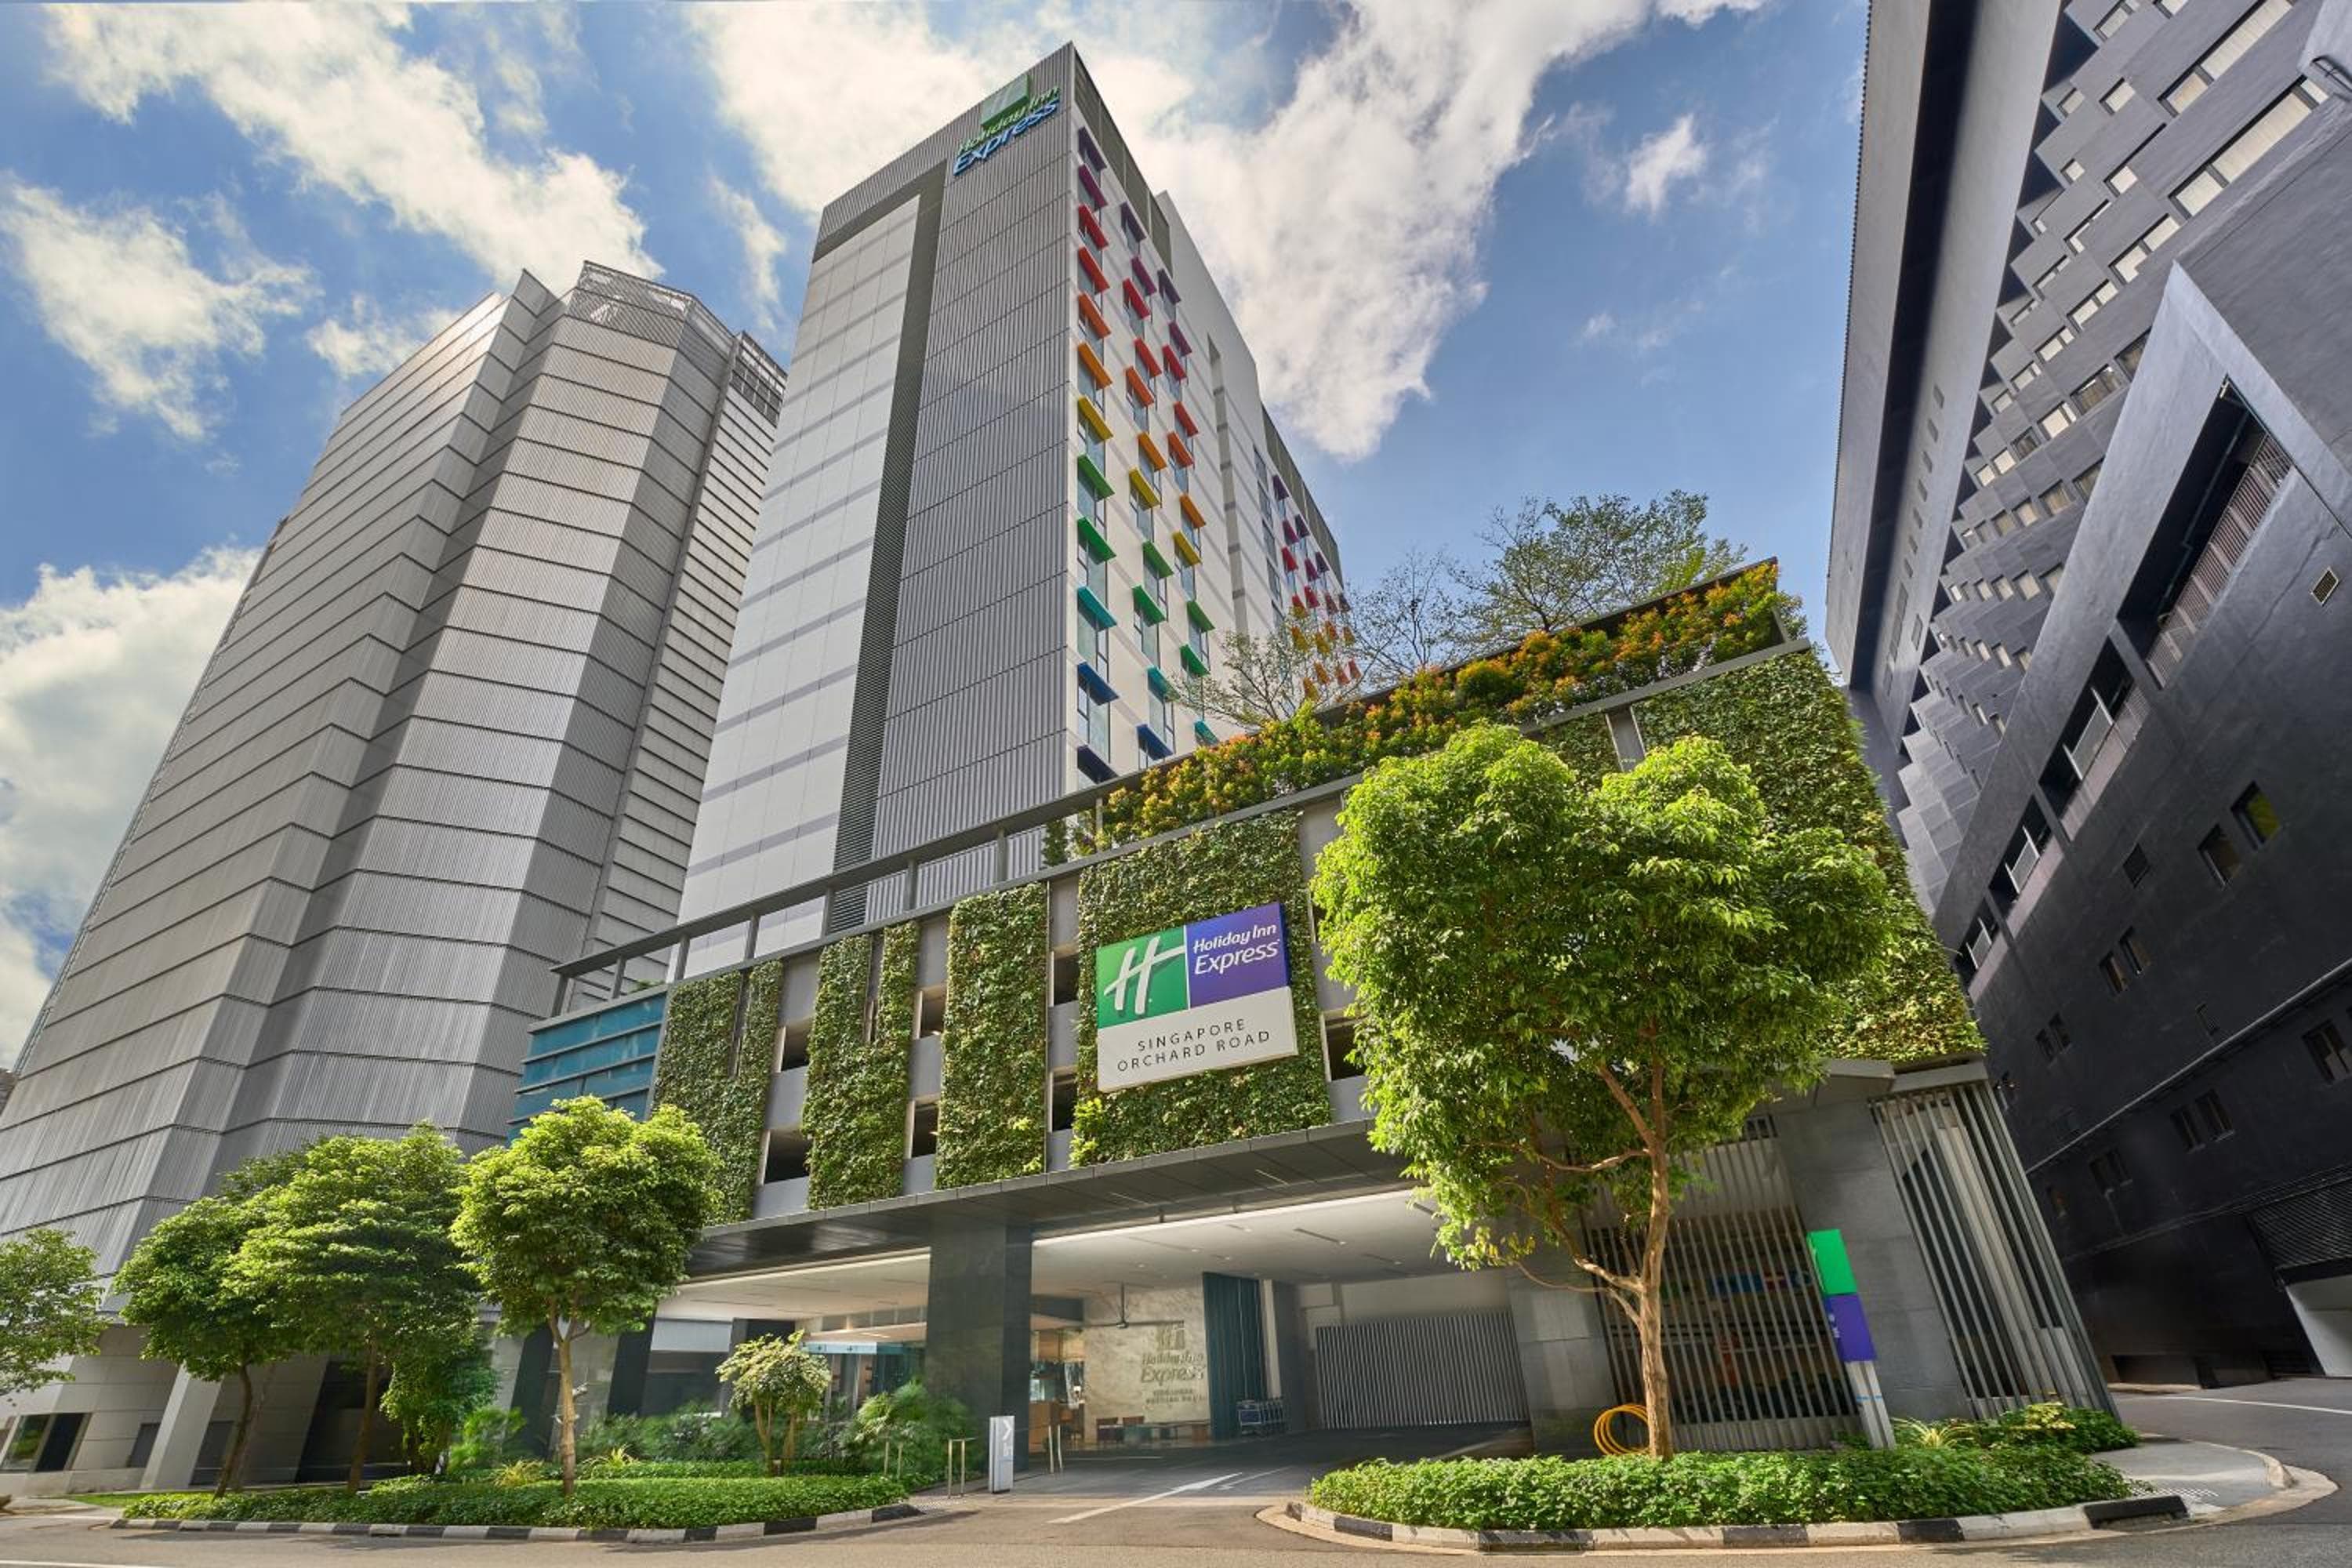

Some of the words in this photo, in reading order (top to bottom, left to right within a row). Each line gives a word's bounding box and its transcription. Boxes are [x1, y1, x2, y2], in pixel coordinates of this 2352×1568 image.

[953, 98, 1058, 176] Express
[1192, 931, 1251, 955] Holiday
[1252, 924, 1278, 939] Inn
[1193, 941, 1279, 975] Express
[1116, 1044, 1207, 1073] ORCHARD
[1215, 1030, 1270, 1053] ROAD
[1137, 1018, 1246, 1052] SINGAPORE
